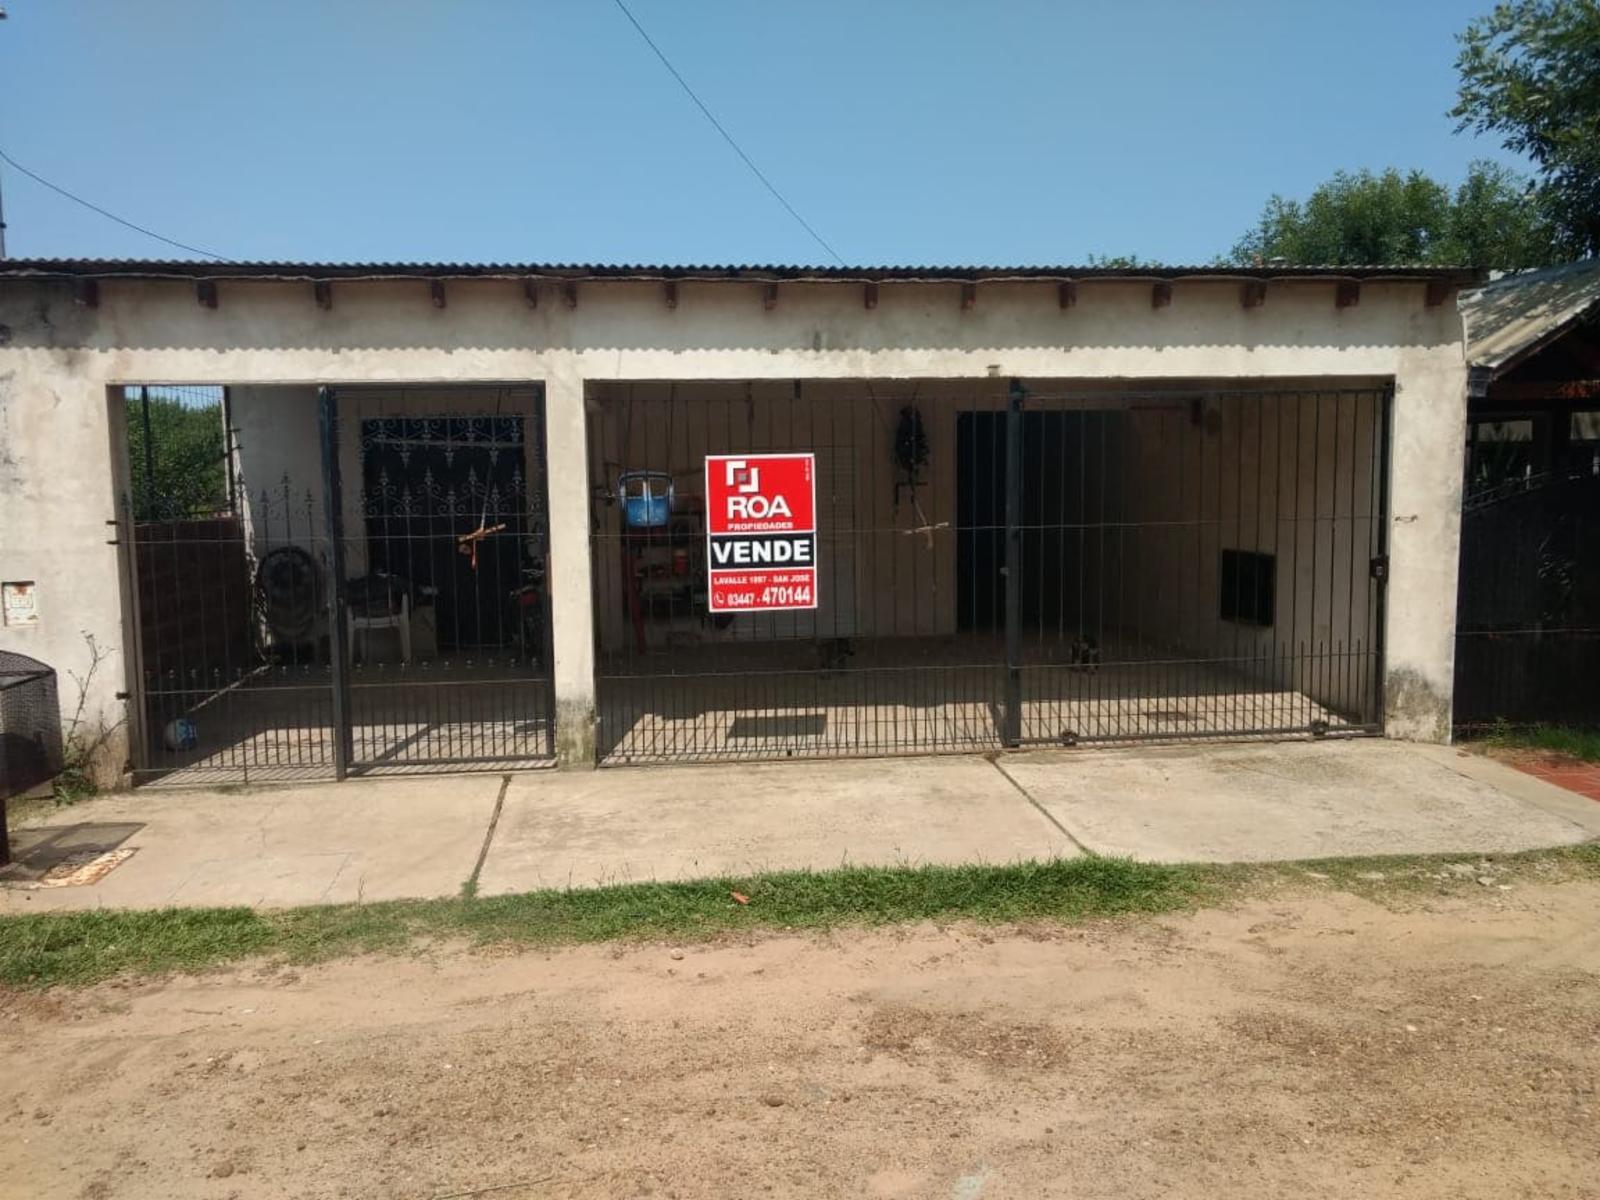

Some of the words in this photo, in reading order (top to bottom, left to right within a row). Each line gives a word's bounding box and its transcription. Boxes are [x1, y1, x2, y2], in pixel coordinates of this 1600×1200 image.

[727, 495, 793, 519] ROA
[727, 522, 793, 531] PROPIEDADES
[712, 540, 811, 563] VENDE
[713, 576, 748, 585] LAVALLE
[773, 575, 789, 583] SAN
[727, 593, 755, 606] 03447
[762, 585, 811, 605] 470144
